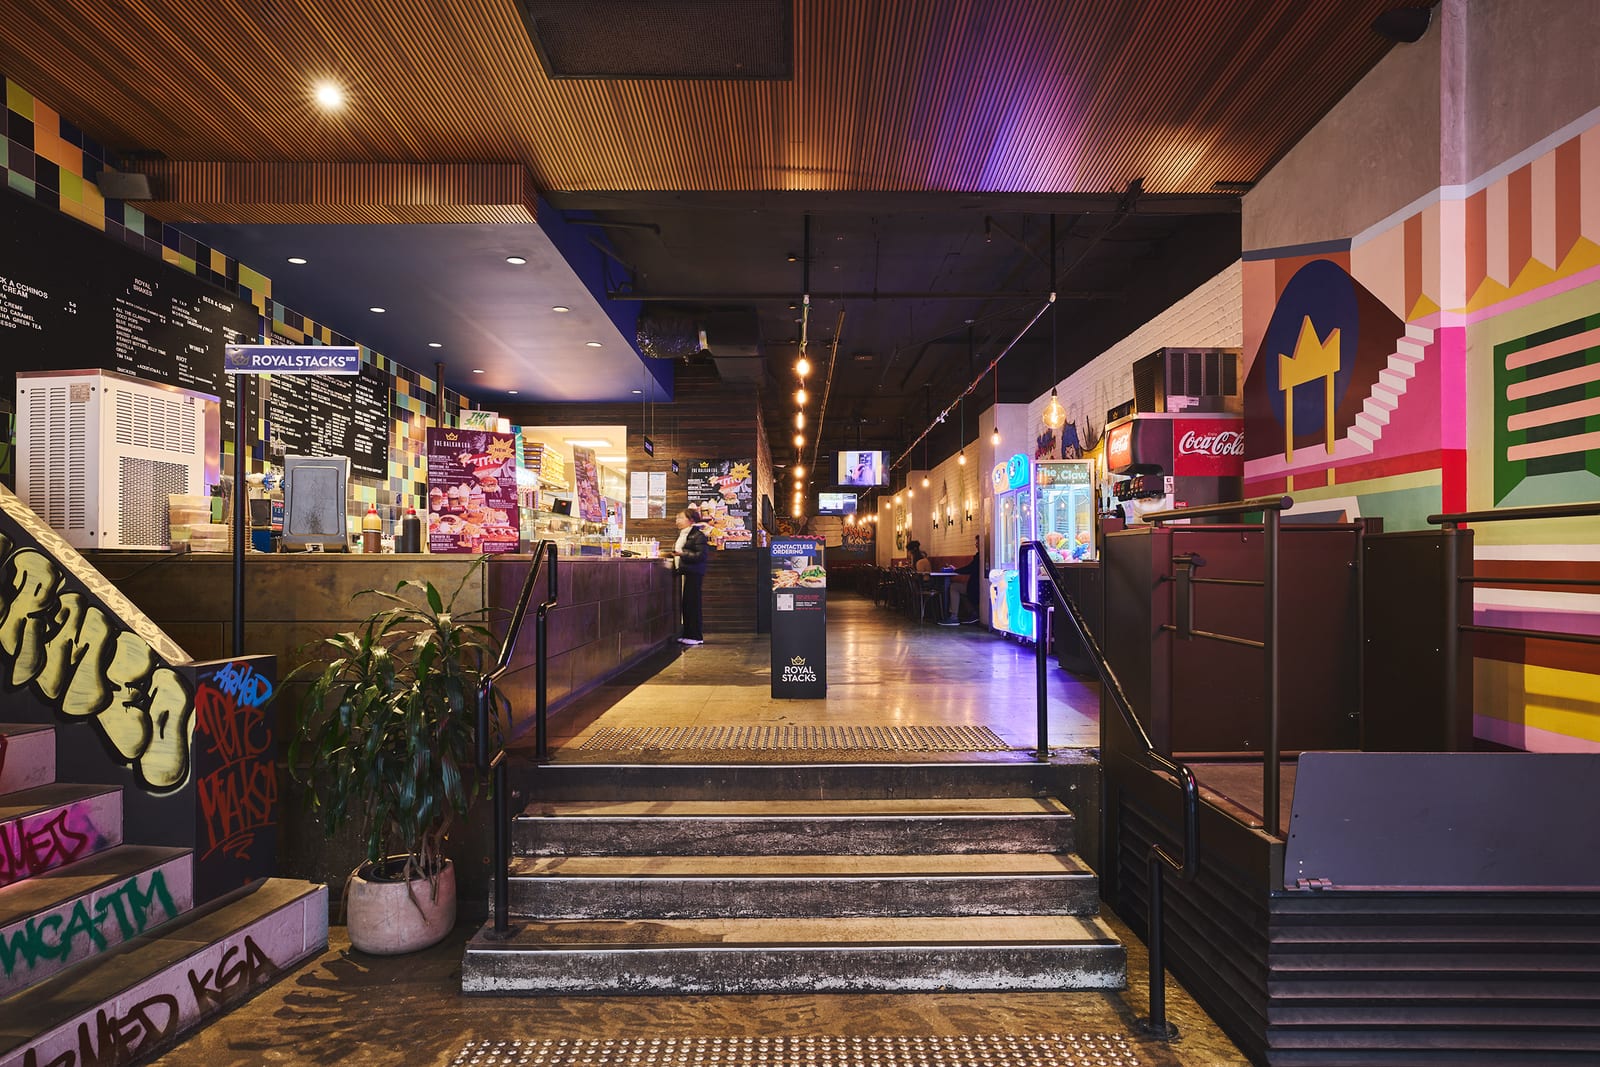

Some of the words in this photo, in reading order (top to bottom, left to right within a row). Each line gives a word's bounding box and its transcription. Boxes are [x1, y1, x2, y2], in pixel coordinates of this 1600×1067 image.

[2, 284, 28, 299] CREAM
[1179, 430, 1245, 456] Coca-Cola
[1060, 469, 1088, 480] Claw
[784, 666, 814, 674] ROYAL
[781, 674, 817, 682] STACKS
